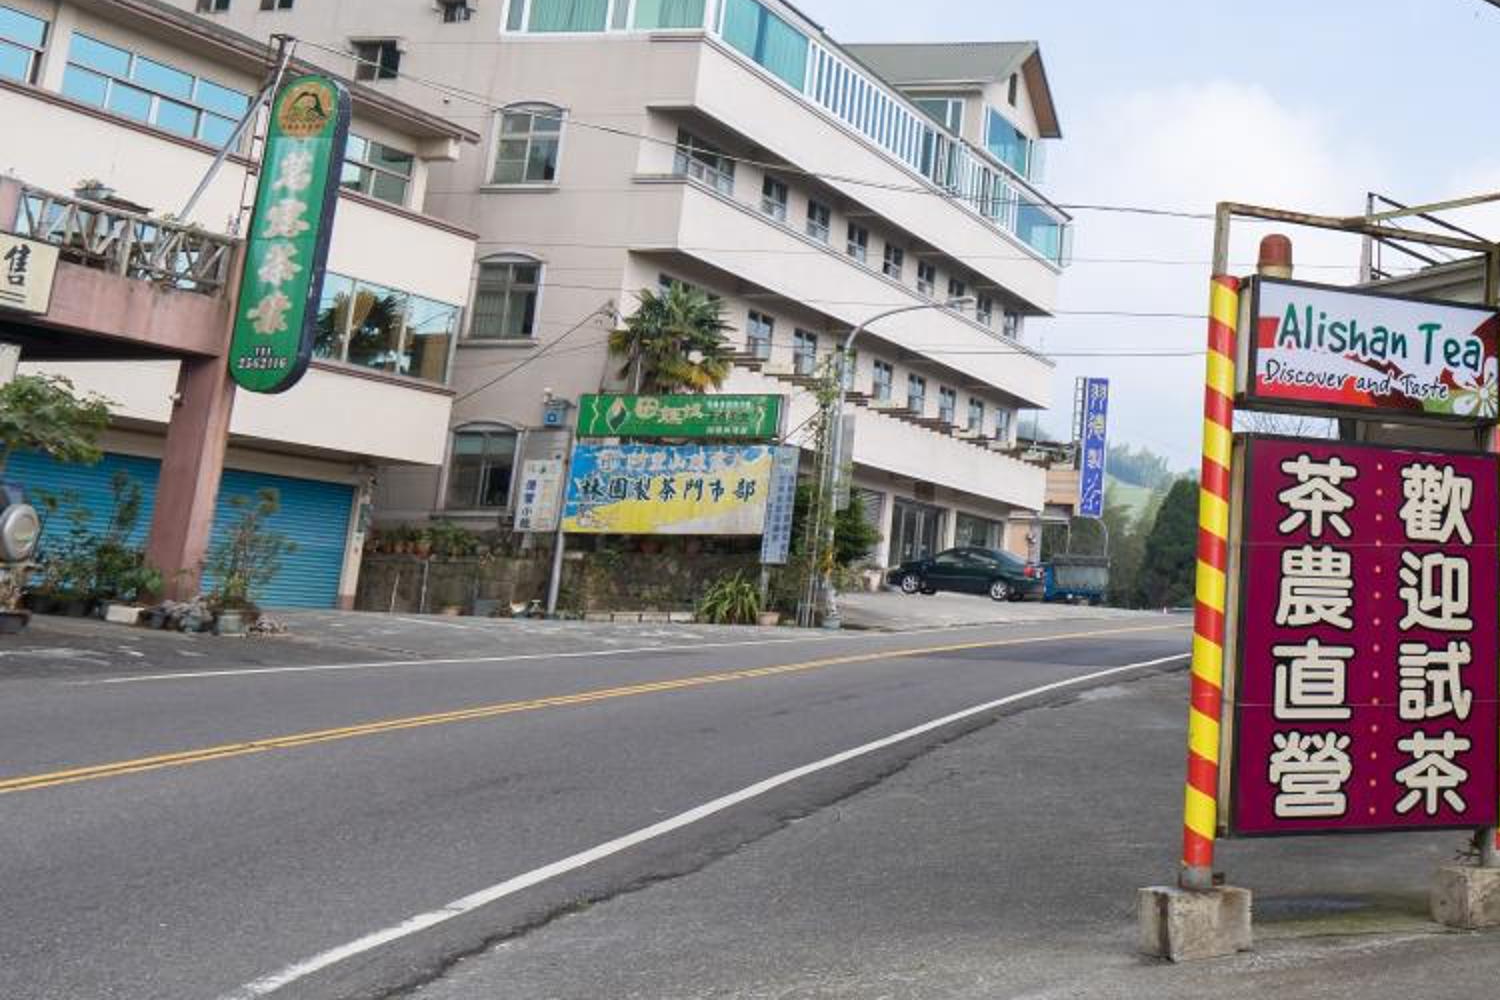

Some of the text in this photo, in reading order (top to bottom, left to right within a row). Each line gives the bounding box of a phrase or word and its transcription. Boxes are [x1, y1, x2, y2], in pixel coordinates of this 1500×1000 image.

[1265, 360, 1449, 398] Discover and Taste
[1277, 303, 1480, 371] Alishan Tea
[1269, 452, 1357, 818] 茶農直營
[1395, 462, 1473, 815] 歡迎試茶
